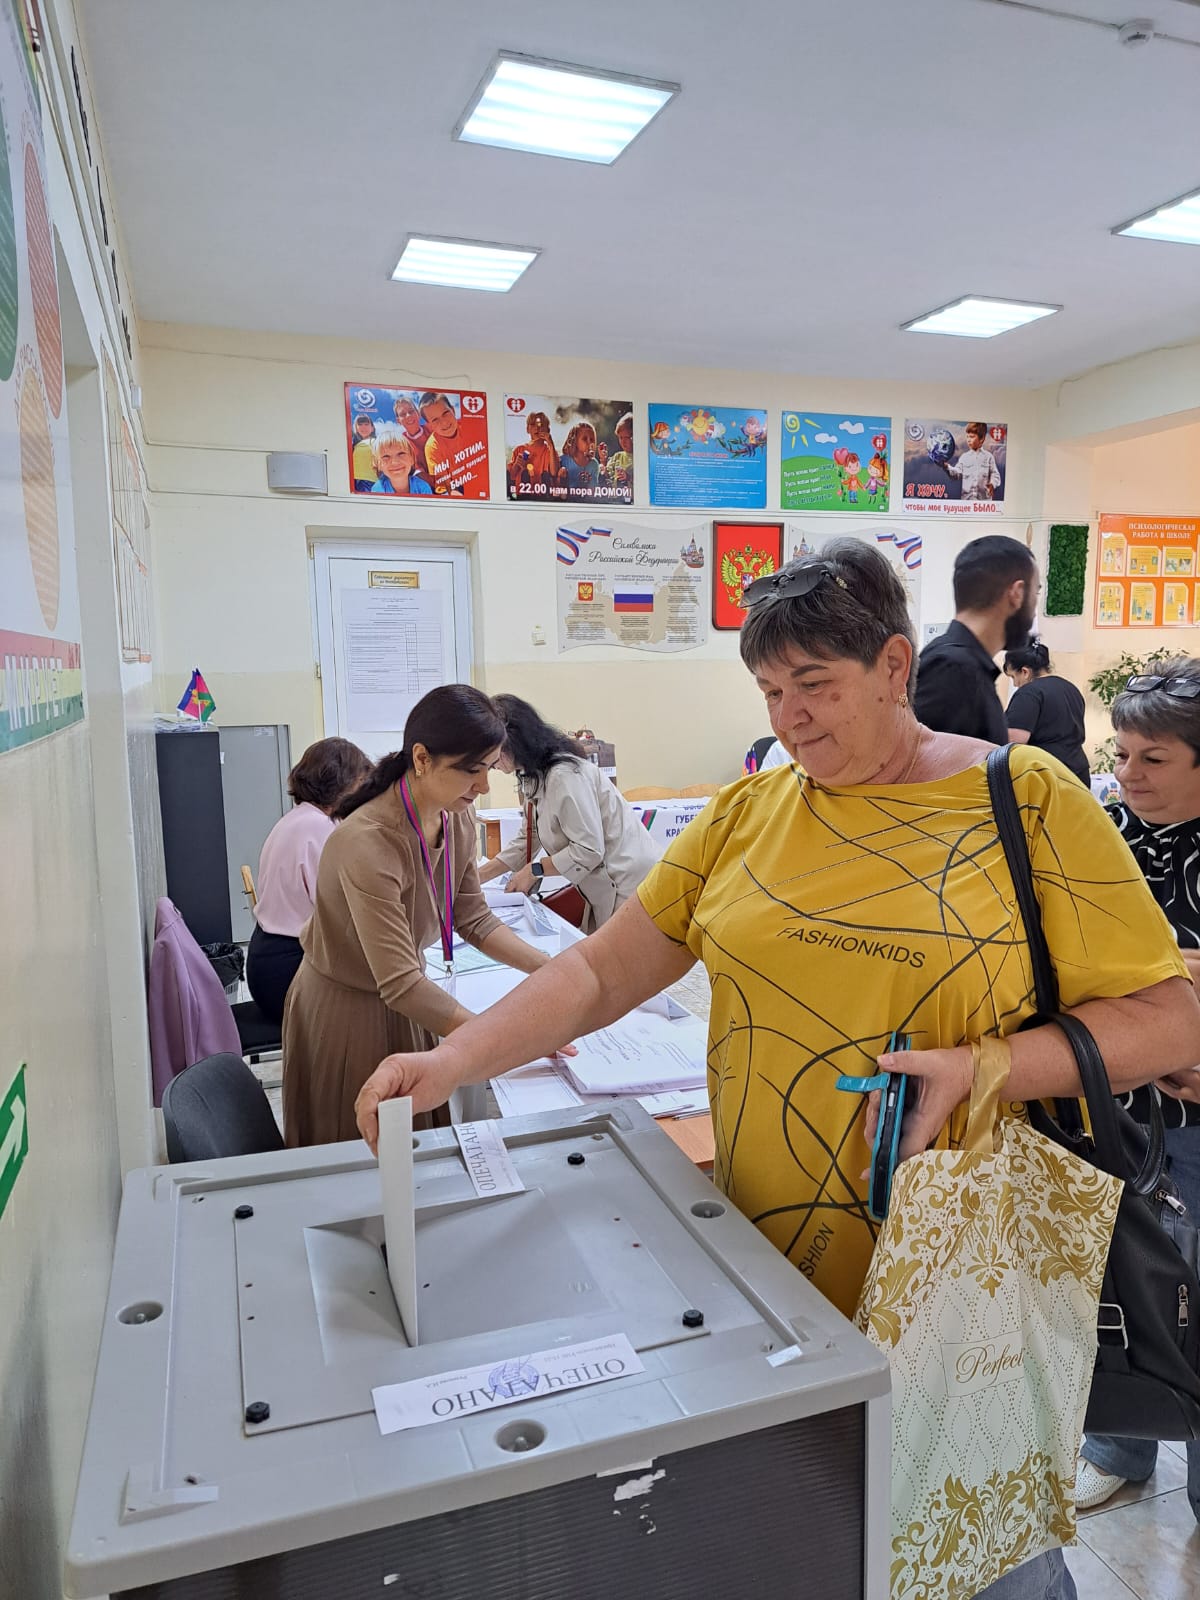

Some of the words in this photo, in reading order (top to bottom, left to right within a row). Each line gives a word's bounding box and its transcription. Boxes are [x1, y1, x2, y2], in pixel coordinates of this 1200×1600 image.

[434, 459, 450, 475] МЫ
[519, 483, 547, 494] 22.00
[549, 487, 568, 495] нам
[570, 487, 592, 497] пора
[594, 486, 632, 498] ДОМОЙ!
[905, 483, 915, 497] Я
[1132, 531, 1159, 539] РАБОТА
[1166, 531, 1191, 539] ШКОЛЕ
[675, 814, 698, 824] ГУБЕ
[665, 827, 685, 838] КРА
[776, 927, 926, 968] FASHIONKIDS
[798, 1222, 835, 1278] SHION
[432, 1358, 626, 1417] ОПЕЧАТАНО
